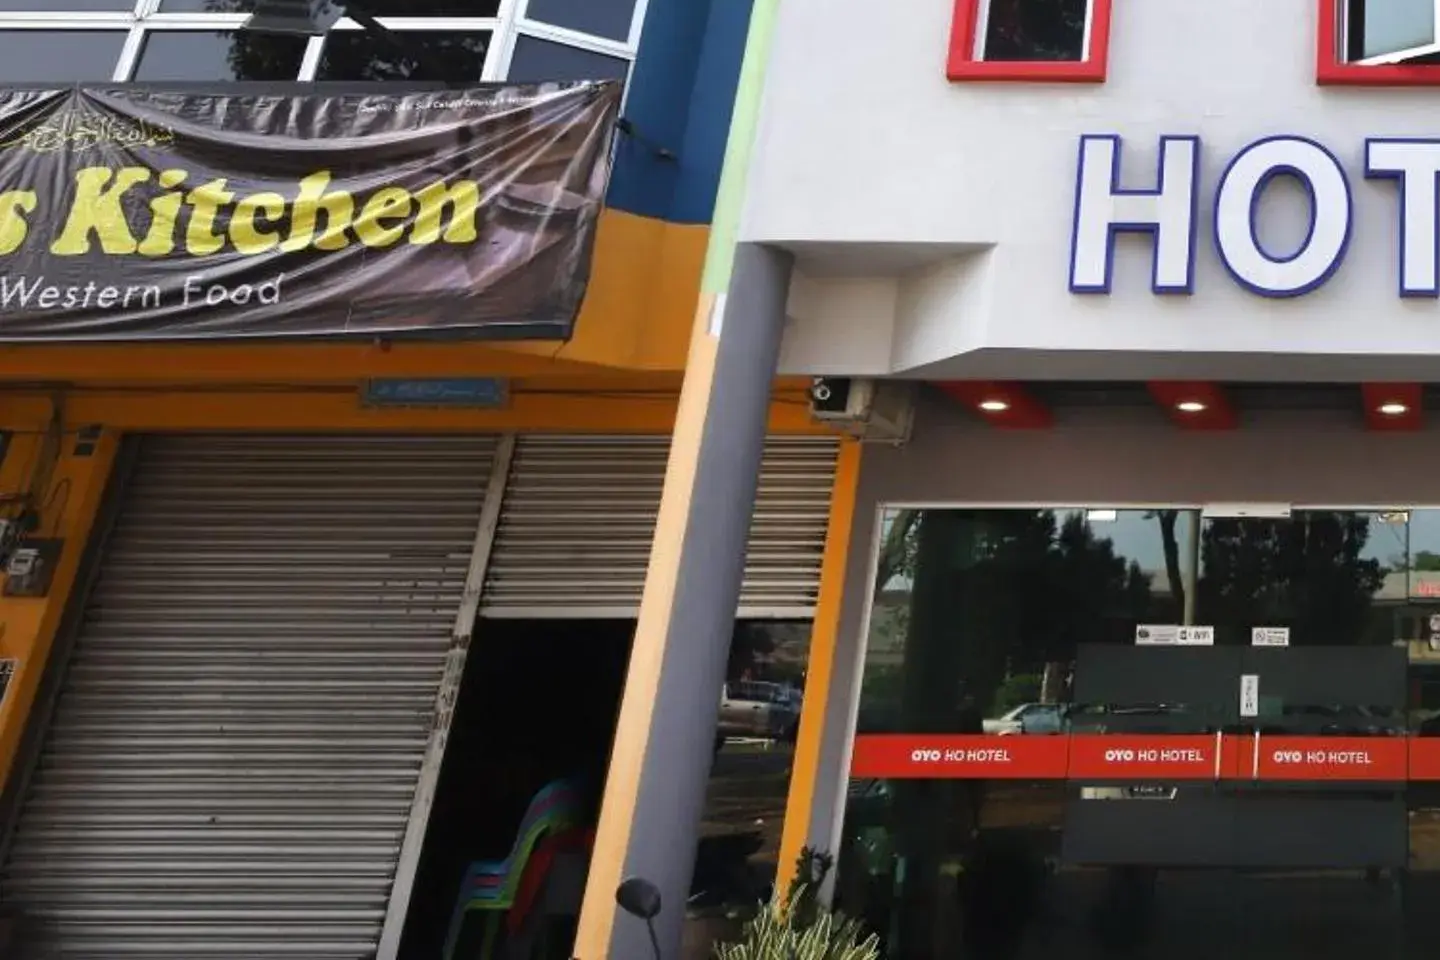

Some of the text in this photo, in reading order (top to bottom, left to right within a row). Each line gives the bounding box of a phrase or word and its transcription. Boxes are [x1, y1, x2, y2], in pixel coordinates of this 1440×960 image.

[50, 167, 479, 256] Kitchen
[0, 272, 285, 309] Western Food
[912, 749, 1011, 762] OYO HO HOTEL
[1105, 749, 1204, 762] OYO HO HOTEL
[1274, 750, 1371, 764] OYO HO HOTEL
